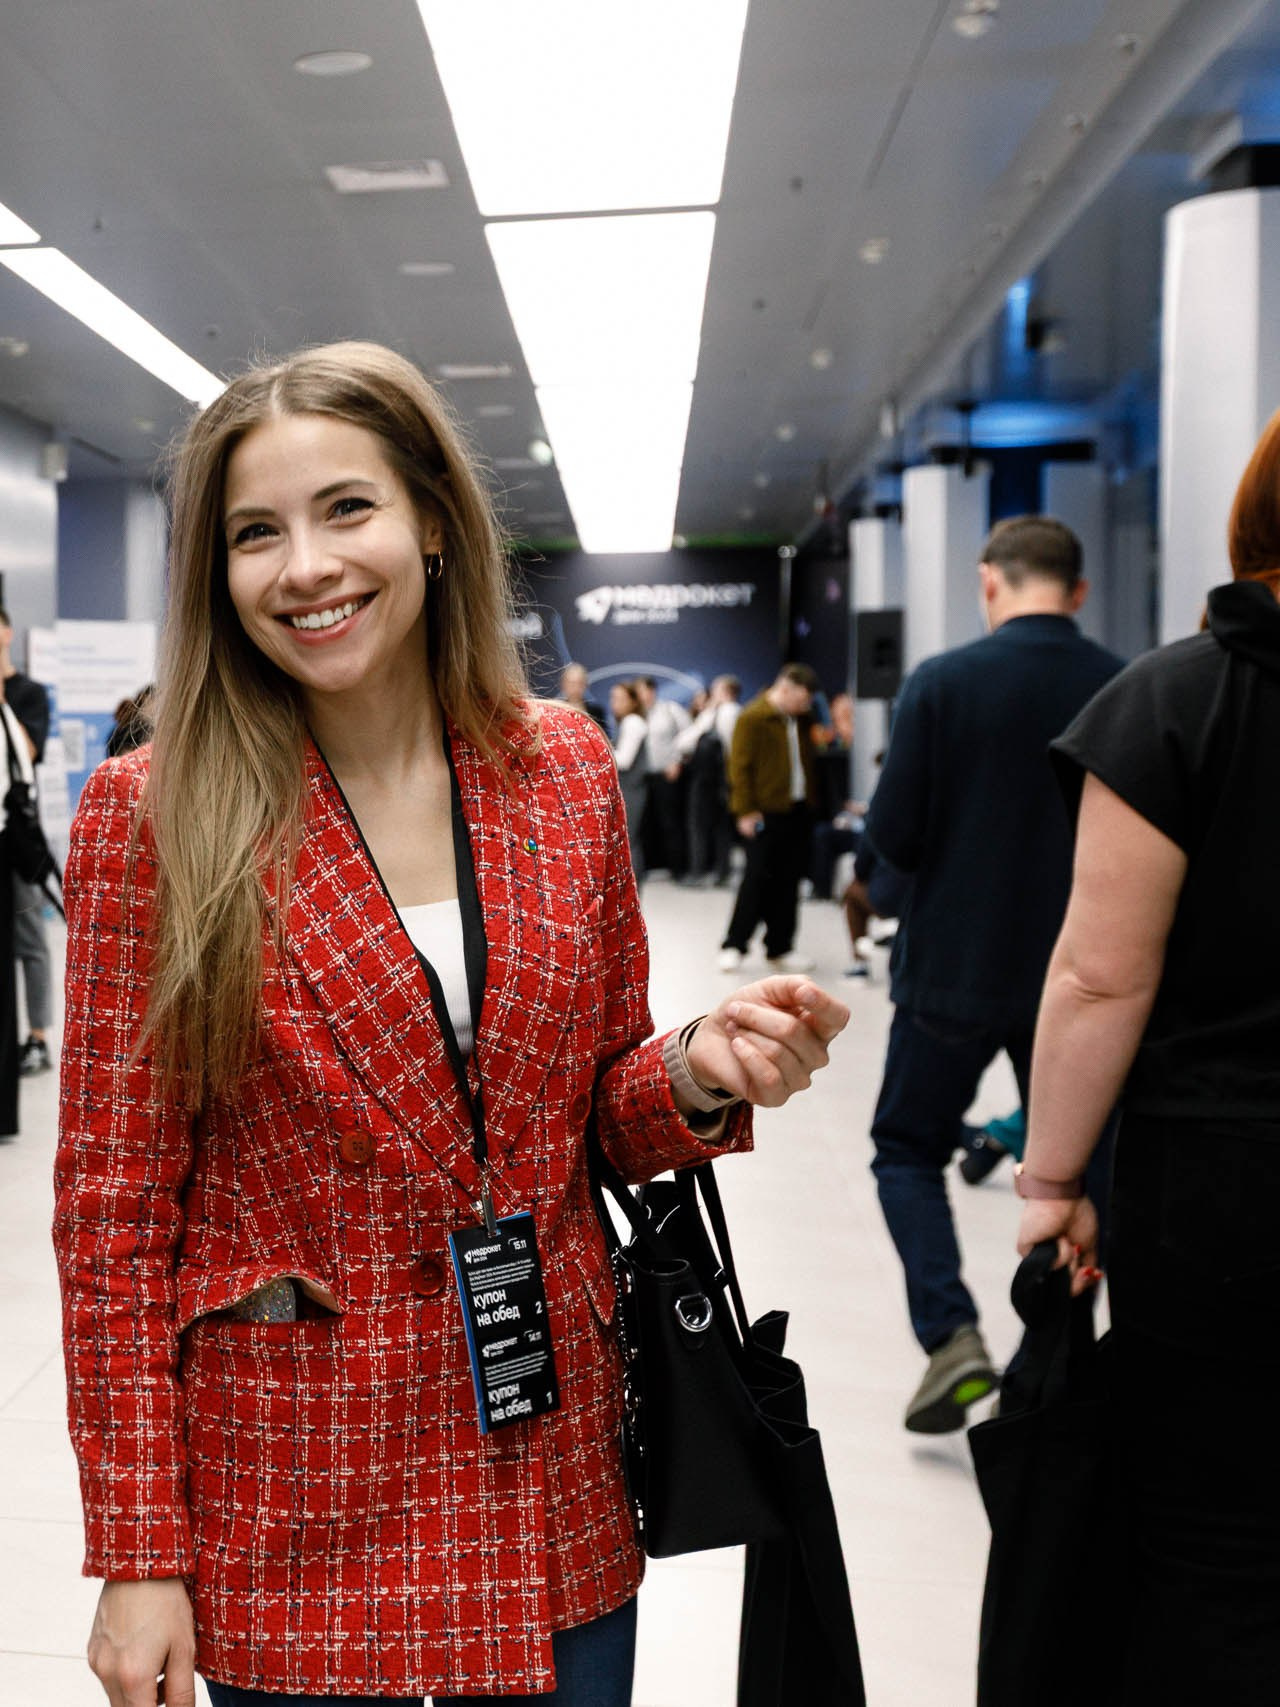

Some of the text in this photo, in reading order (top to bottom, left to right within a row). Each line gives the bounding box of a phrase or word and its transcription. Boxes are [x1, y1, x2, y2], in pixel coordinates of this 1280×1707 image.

[513, 1239, 527, 1250] 15.11
[472, 1288, 507, 1310] купон
[535, 1300, 543, 1314] 2
[476, 1304, 521, 1328] на обед
[488, 1382, 521, 1405] купон
[546, 1391, 553, 1405] 1
[490, 1398, 533, 1423] на обед
